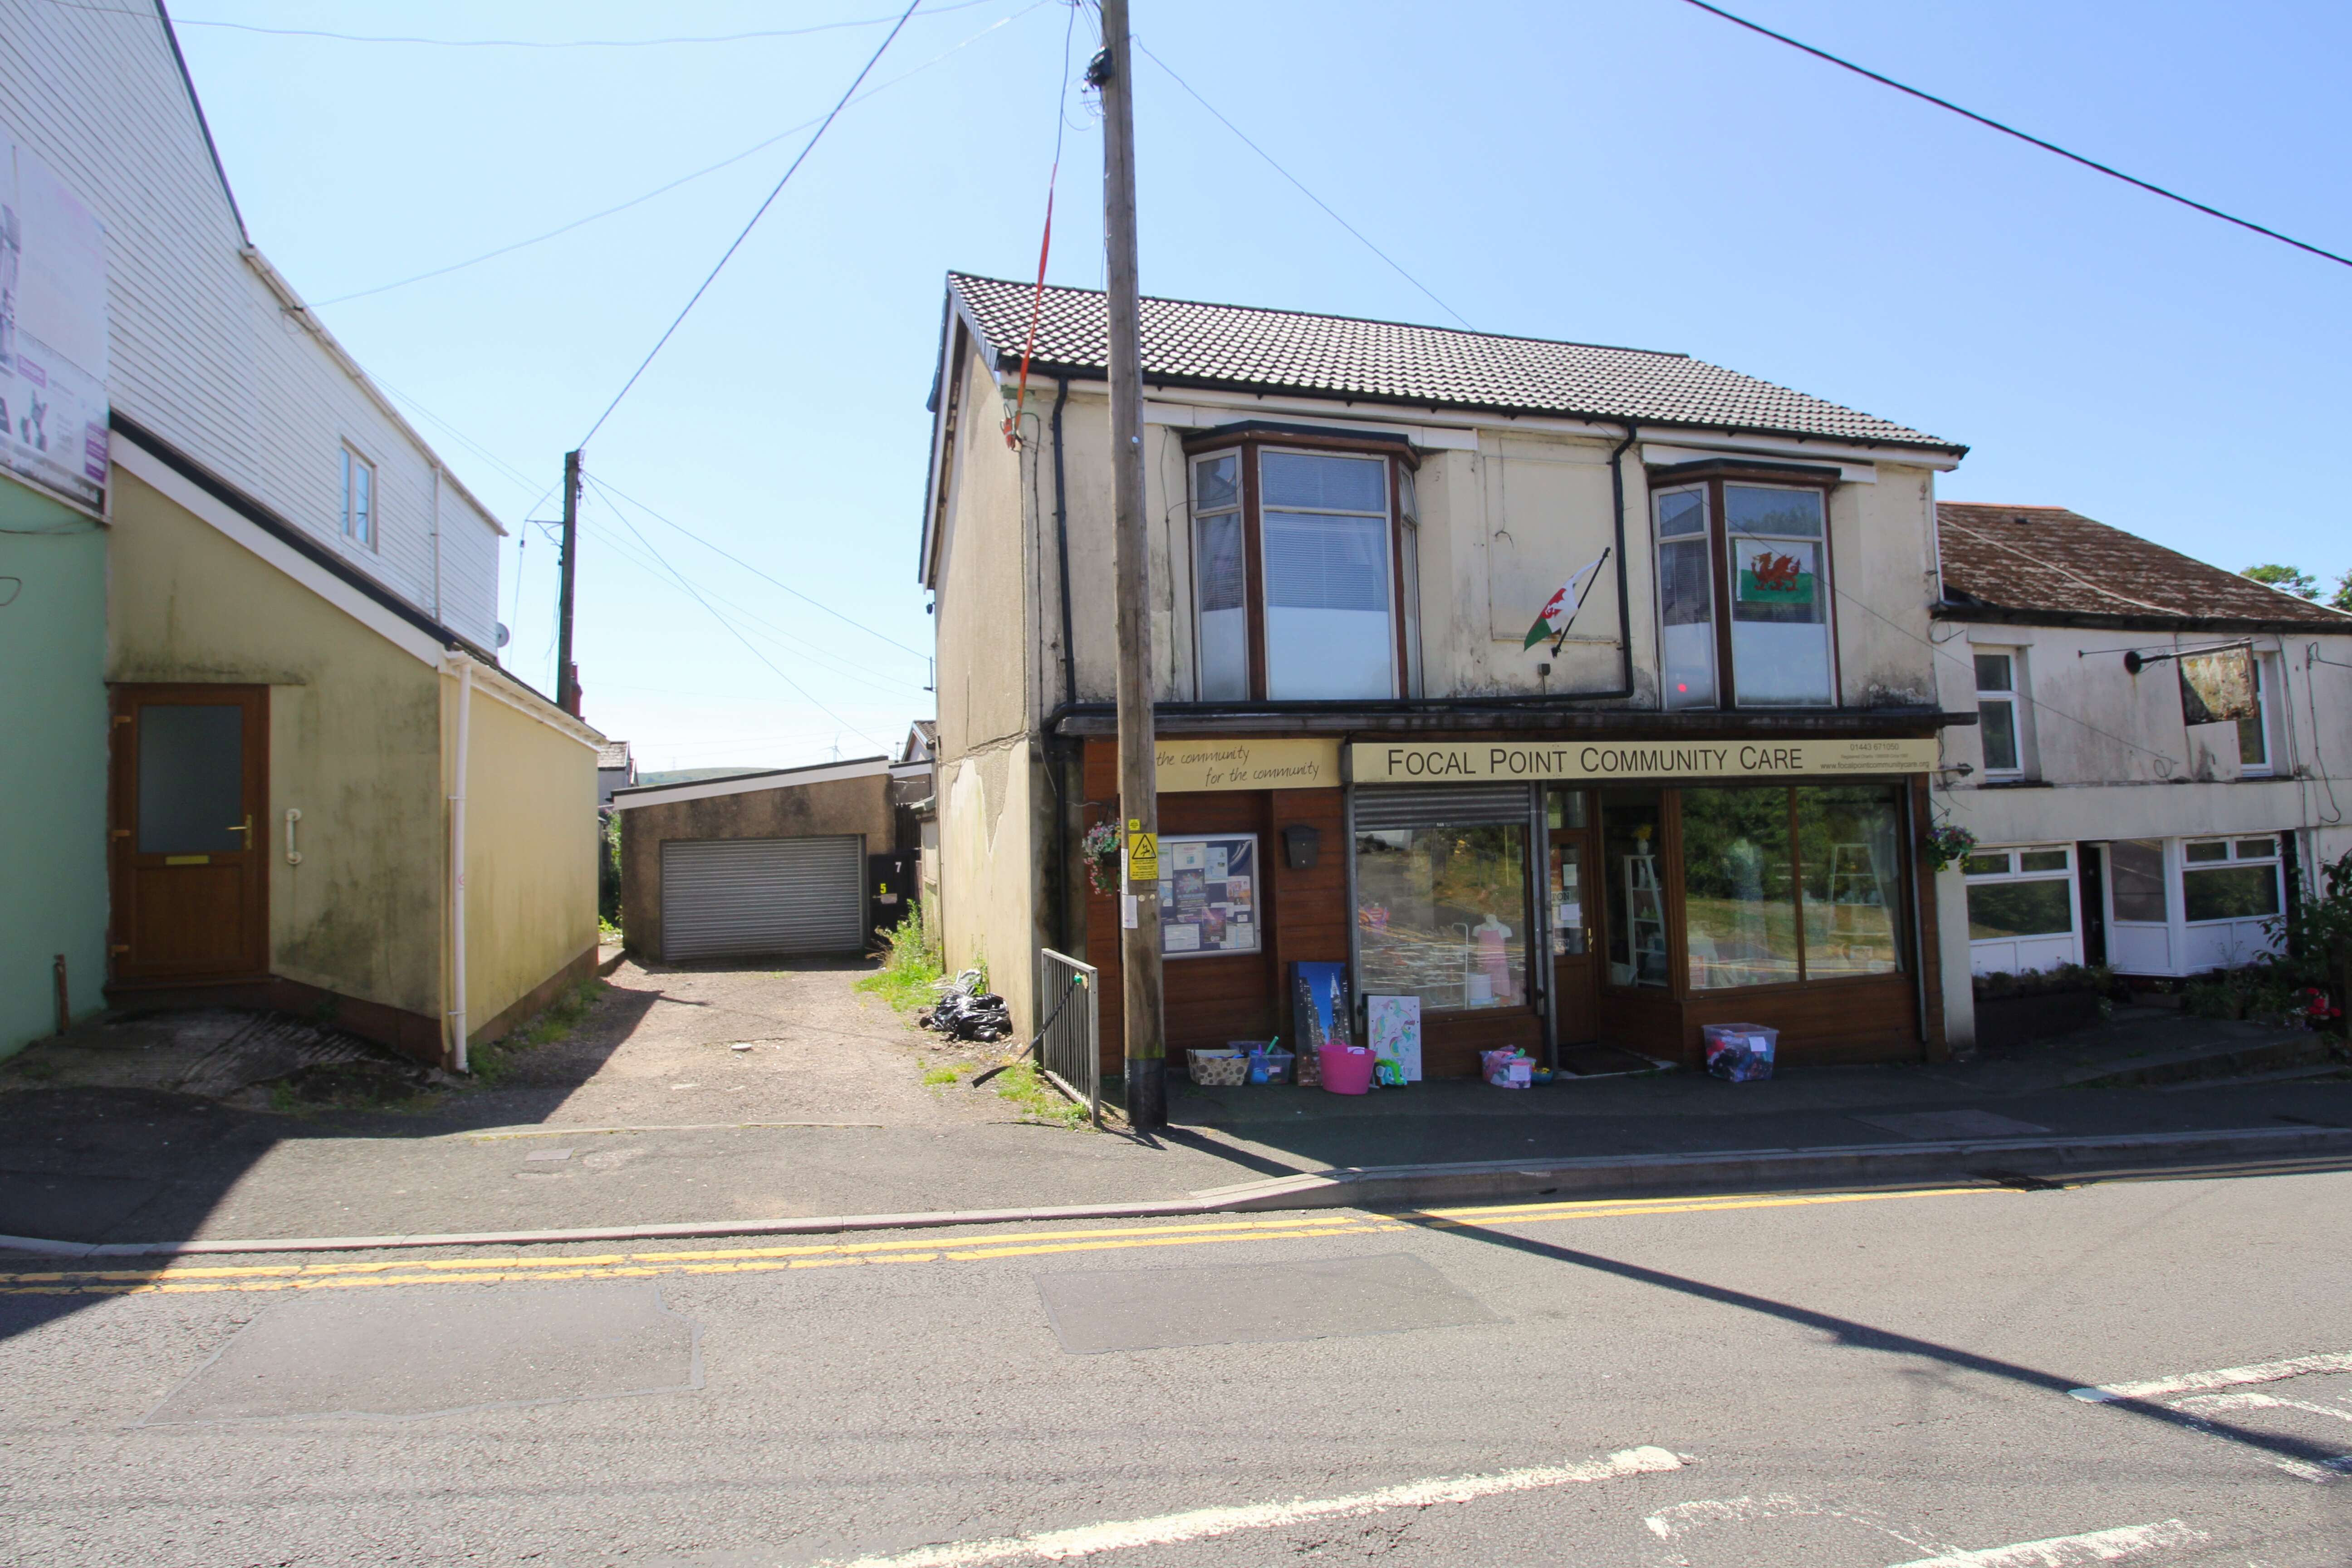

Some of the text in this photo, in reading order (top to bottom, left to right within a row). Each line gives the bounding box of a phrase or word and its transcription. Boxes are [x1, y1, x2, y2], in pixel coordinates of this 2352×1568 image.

[1156, 745, 1250, 766] the community
[1388, 745, 1803, 775] FOCAL POINT COMMUNITY CARE
[1820, 761, 1930, 769] www.focalpointcommunitycare.org
[1205, 761, 1319, 786] for the community
[895, 862, 902, 872] 7
[880, 883, 887, 894] 5
